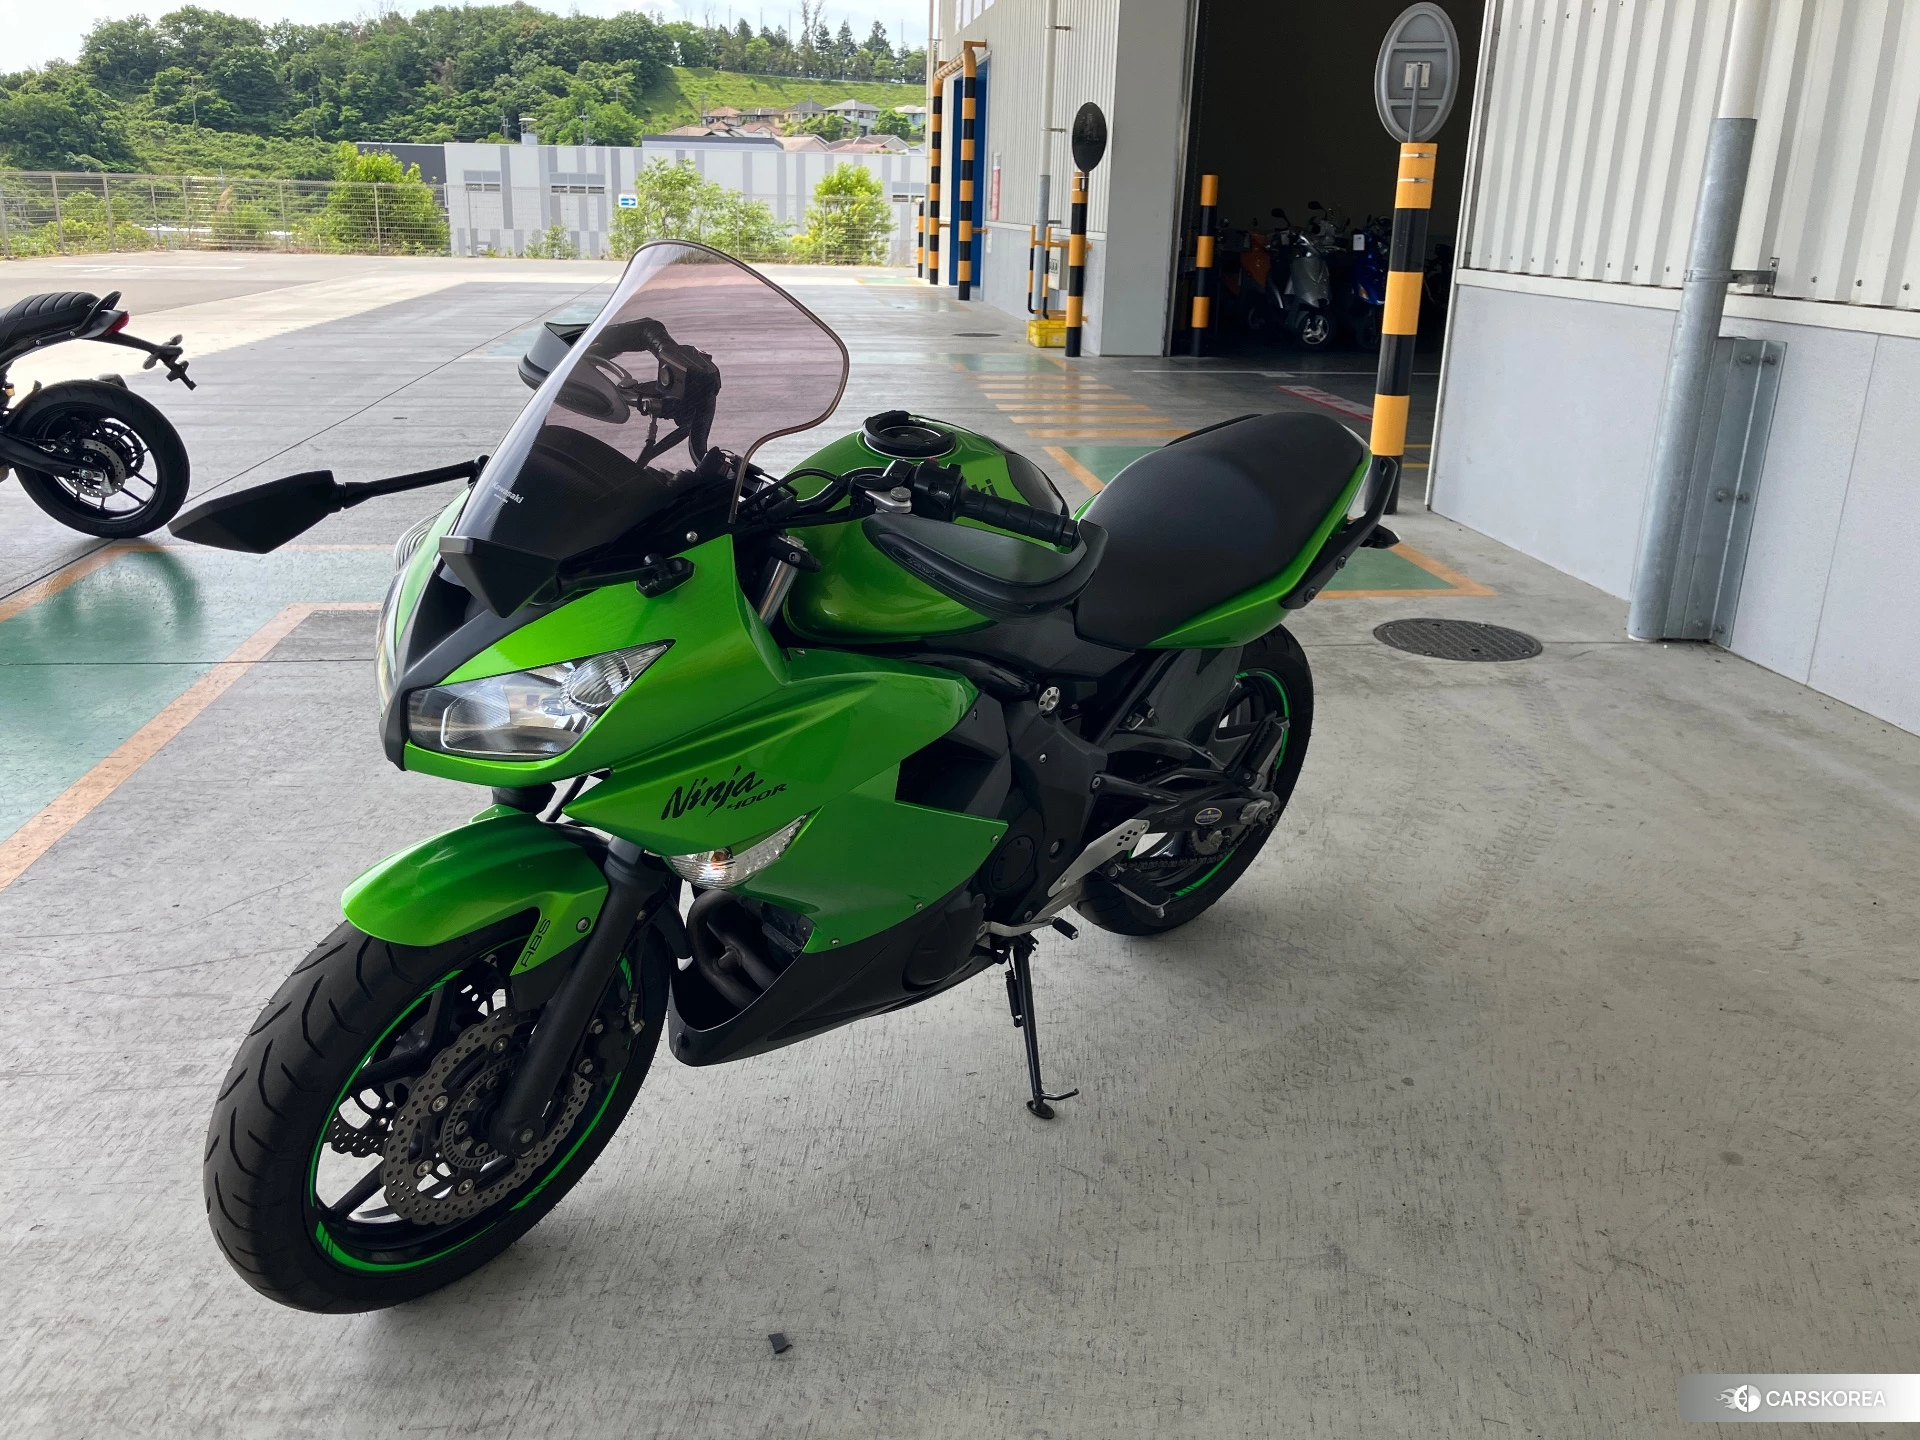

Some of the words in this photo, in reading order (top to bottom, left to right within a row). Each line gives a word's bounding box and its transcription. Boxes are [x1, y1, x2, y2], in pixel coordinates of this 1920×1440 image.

[660, 765, 764, 820] Ninja
[727, 783, 788, 810] 400R
[520, 918, 551, 968] ABS
